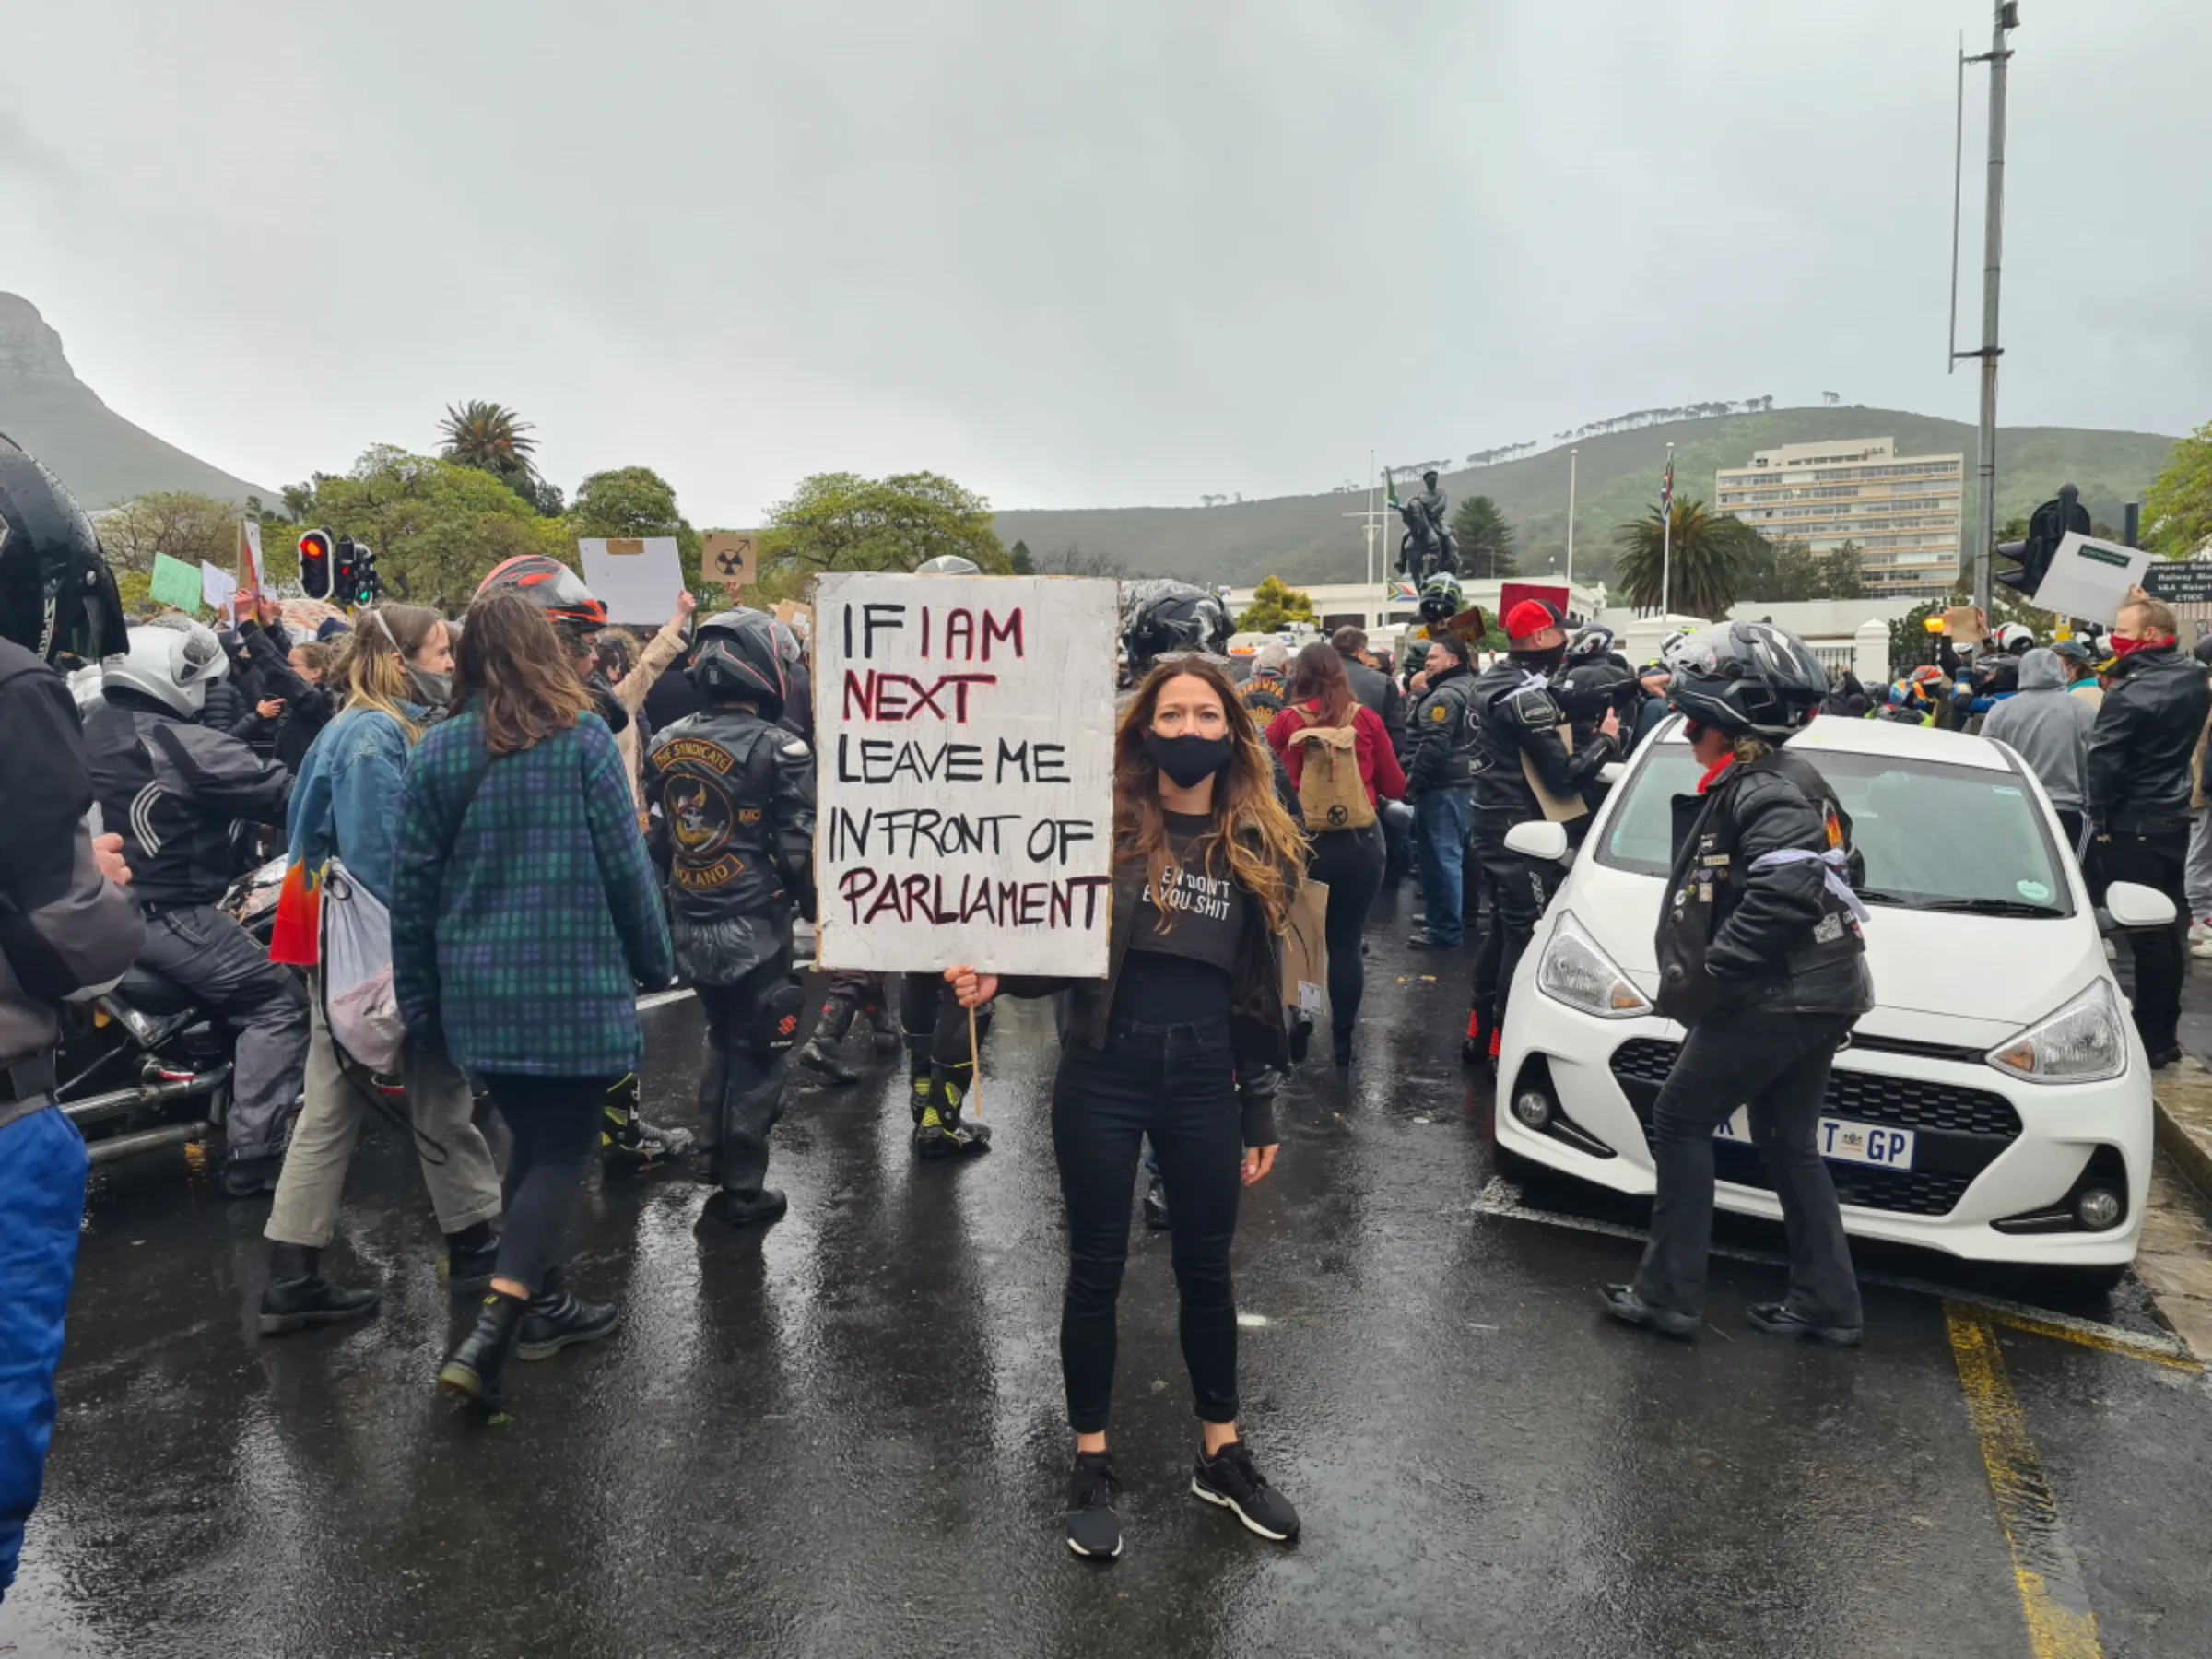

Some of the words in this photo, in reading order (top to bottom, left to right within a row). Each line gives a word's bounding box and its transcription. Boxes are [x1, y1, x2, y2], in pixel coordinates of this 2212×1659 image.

[843, 603, 905, 658] IF
[921, 606, 929, 657] I
[945, 606, 1023, 661] AM
[842, 668, 997, 724] NEXT
[838, 734, 983, 783] LEAVE
[996, 736, 1071, 784] ME
[1027, 818, 1094, 865] OF
[839, 866, 1112, 929] PARLIAMENT
[1186, 873, 1230, 899] DON'T
[1194, 895, 1230, 921] SHIT
[1867, 1130, 1905, 1163] GP
